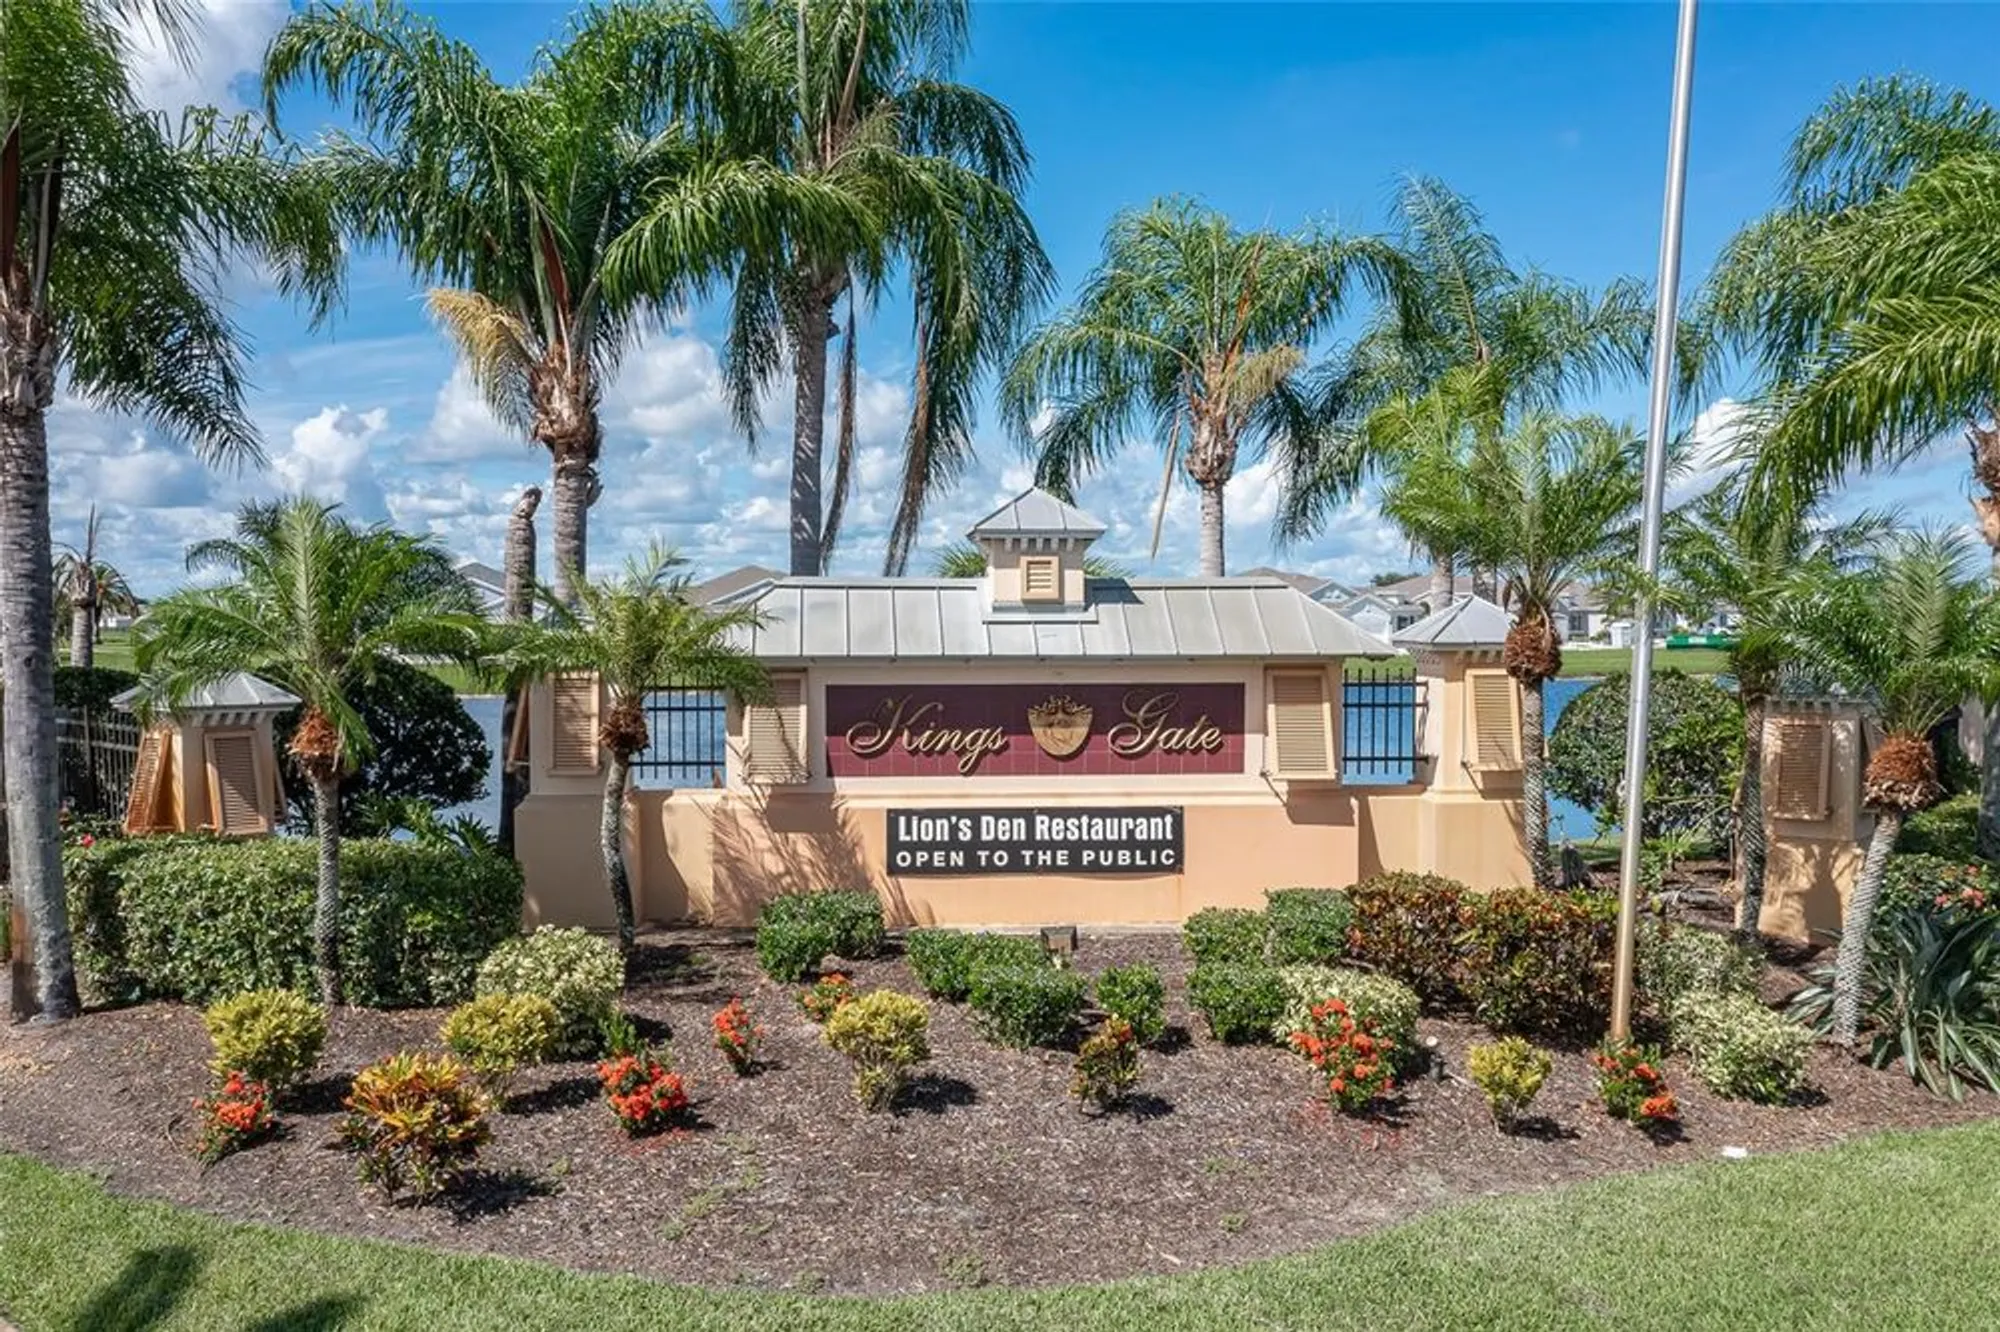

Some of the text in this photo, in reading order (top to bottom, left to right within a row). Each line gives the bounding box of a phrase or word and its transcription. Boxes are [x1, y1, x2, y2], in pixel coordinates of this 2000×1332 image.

[845, 690, 1224, 774] Kings Gate
[898, 814, 1173, 841] Lion's Den Restaurant
[896, 849, 1176, 867] OPEN TO THE PUBLIC
